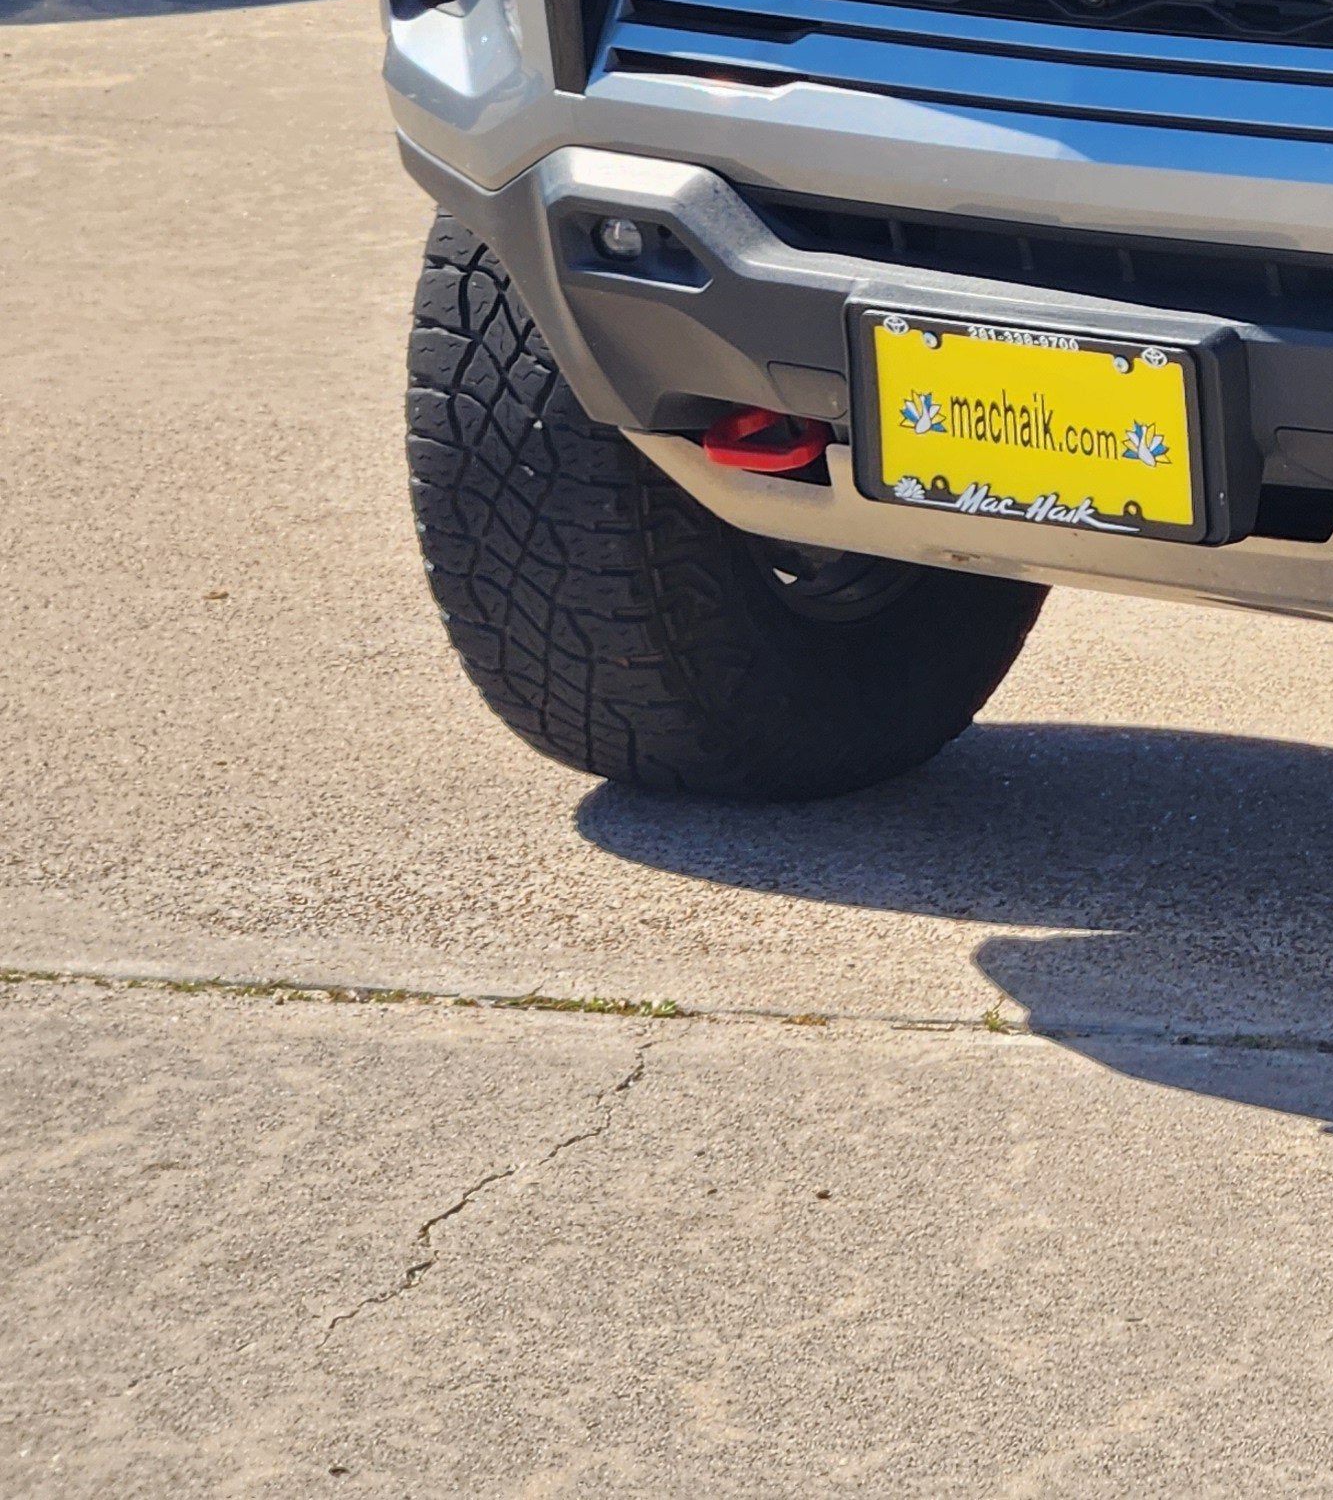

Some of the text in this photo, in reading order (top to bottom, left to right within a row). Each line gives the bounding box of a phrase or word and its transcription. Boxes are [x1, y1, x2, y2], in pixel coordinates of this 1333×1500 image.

[966, 325, 1080, 351] 281-338-9700
[950, 389, 1119, 460] machaik.com
[955, 483, 1118, 528] Mac Haik
